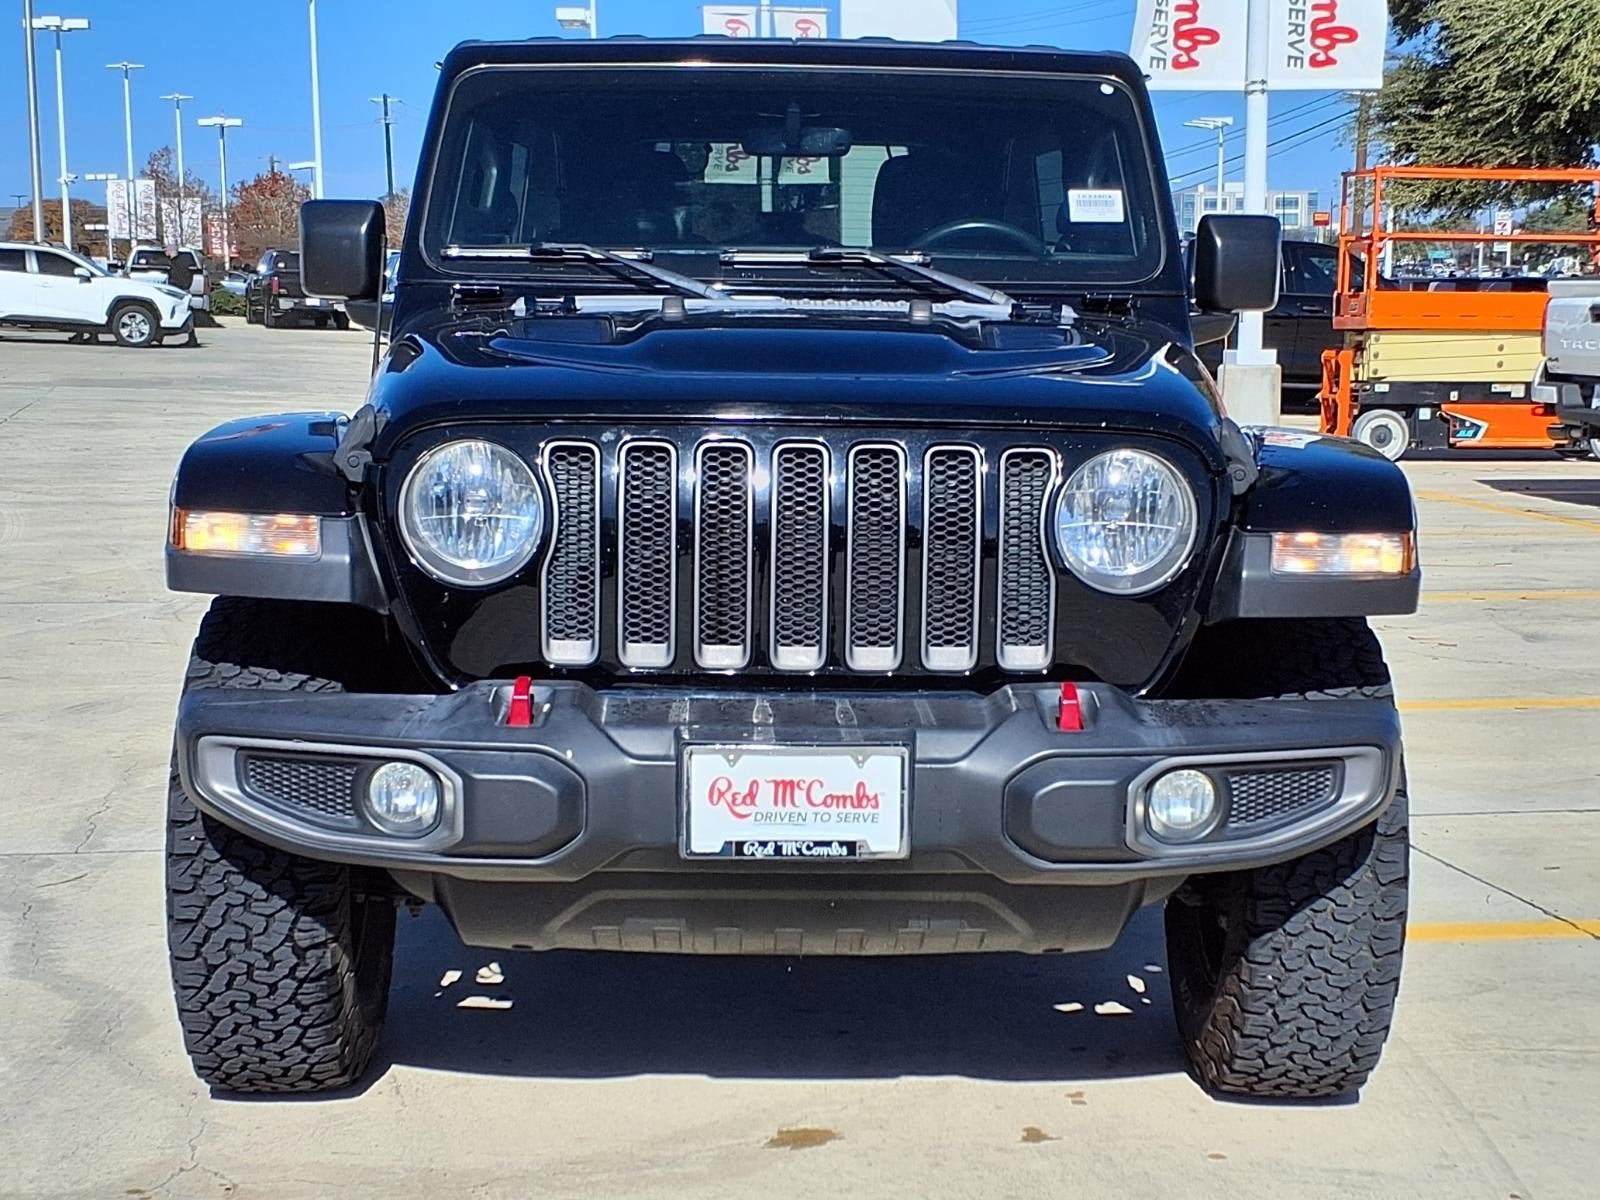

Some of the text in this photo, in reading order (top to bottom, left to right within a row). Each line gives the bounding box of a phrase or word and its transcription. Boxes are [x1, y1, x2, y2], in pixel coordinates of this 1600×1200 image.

[708, 776, 879, 819] Red McCombs
[754, 812, 879, 824] DRIVEN TO SERVE
[743, 841, 847, 857] Red McCombs
